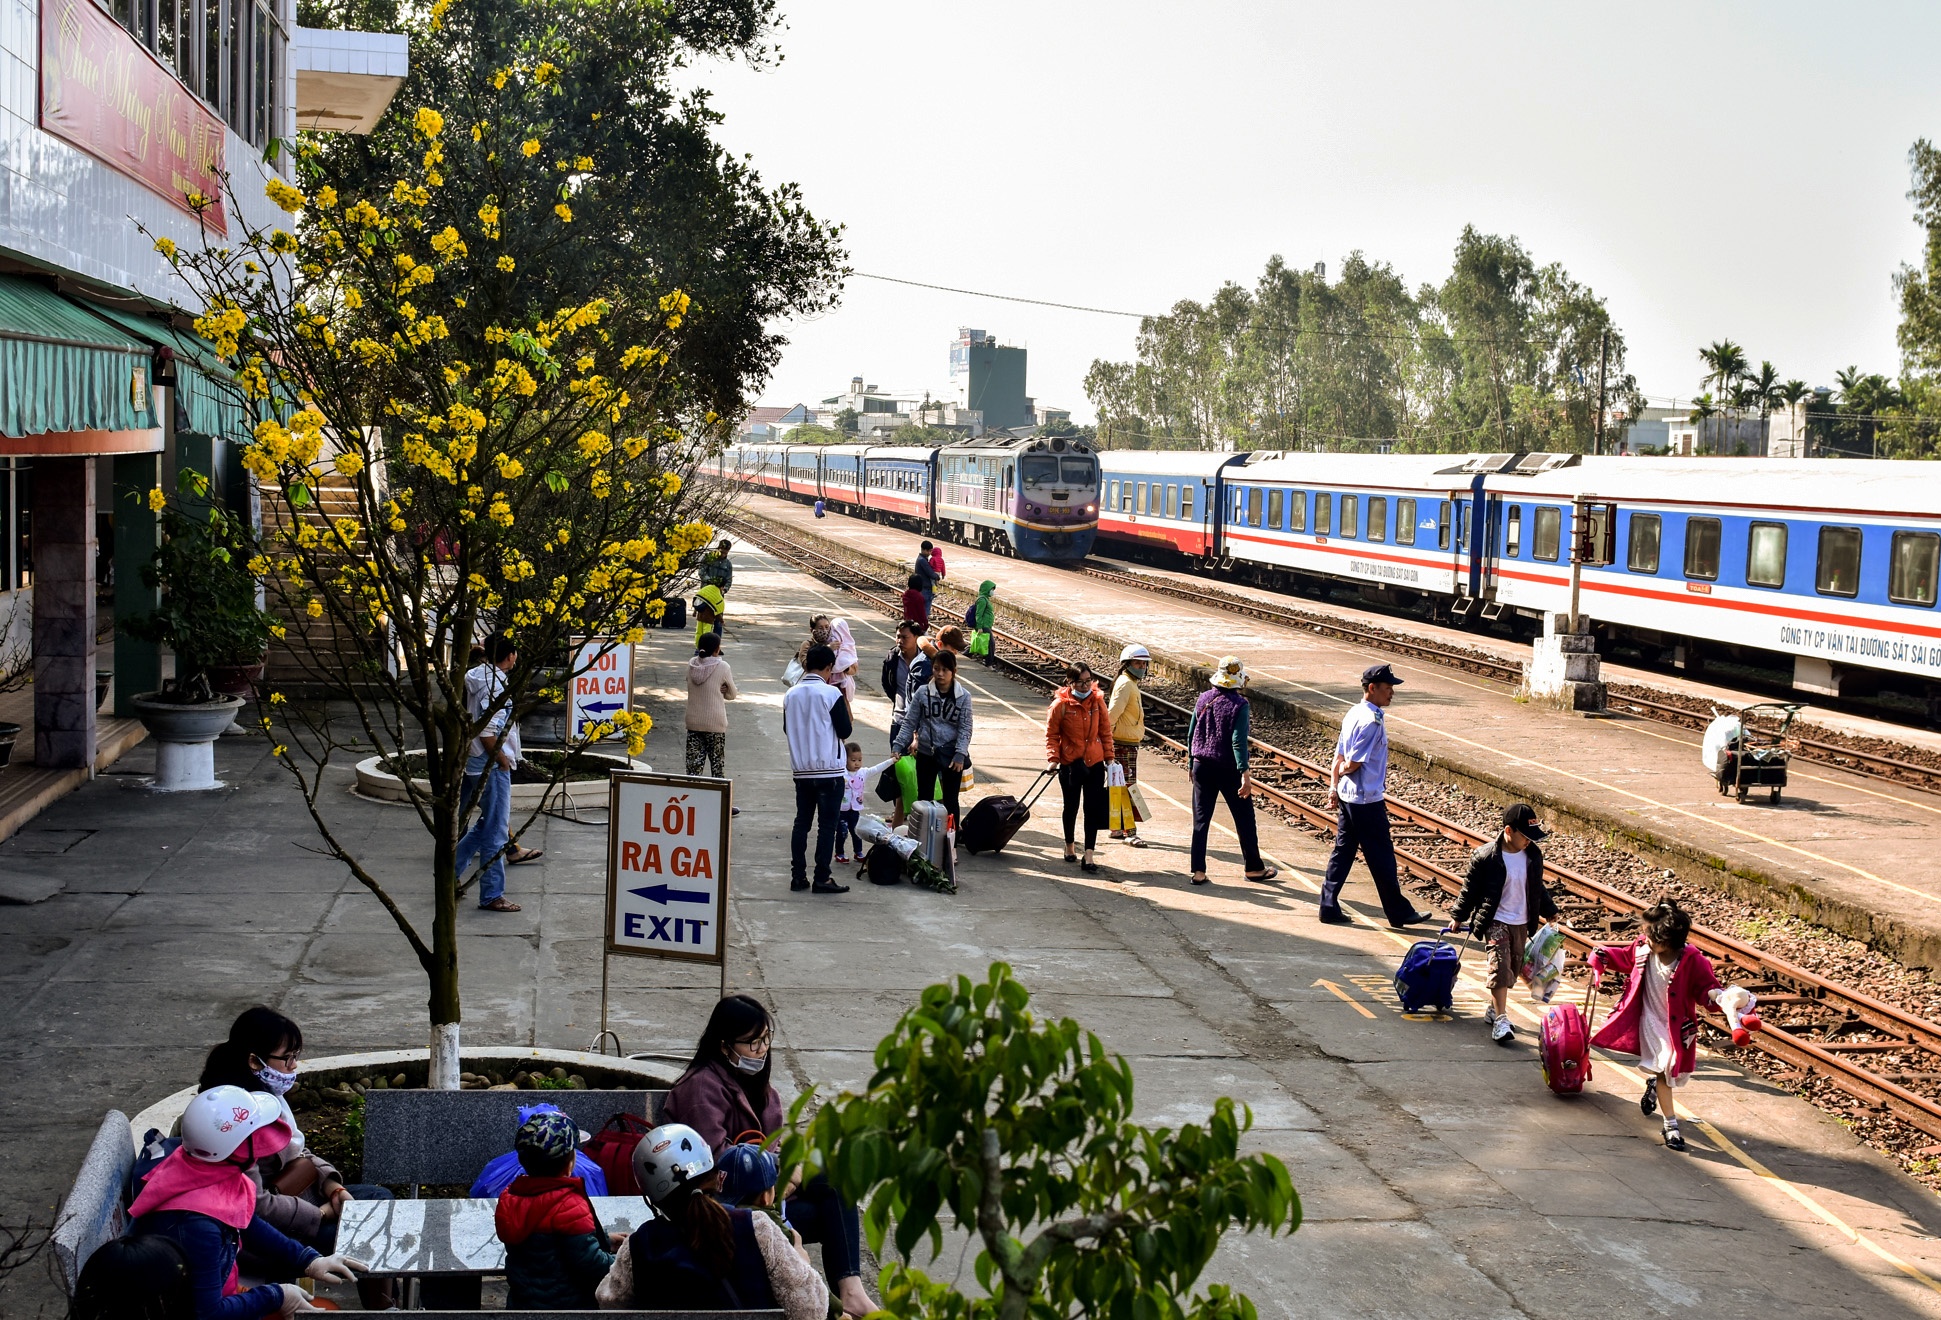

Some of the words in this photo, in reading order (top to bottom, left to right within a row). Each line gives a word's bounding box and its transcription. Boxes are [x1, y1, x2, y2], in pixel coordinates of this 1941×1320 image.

[1780, 623, 1801, 644] CÔNG
[1803, 629, 1813, 647] TY
[1814, 631, 1826, 648] CP
[1827, 629, 1844, 655] VẬN
[1860, 634, 1890, 659] ĐƯỜNG
[1892, 636, 1910, 662] SẮT
[1911, 641, 1927, 665] SÀI
[576, 677, 600, 695] RA
[604, 677, 627, 695] GA
[643, 794, 696, 836] LỐI
[621, 841, 663, 875] RA
[670, 846, 714, 879] GA
[623, 912, 709, 945] EXIT
